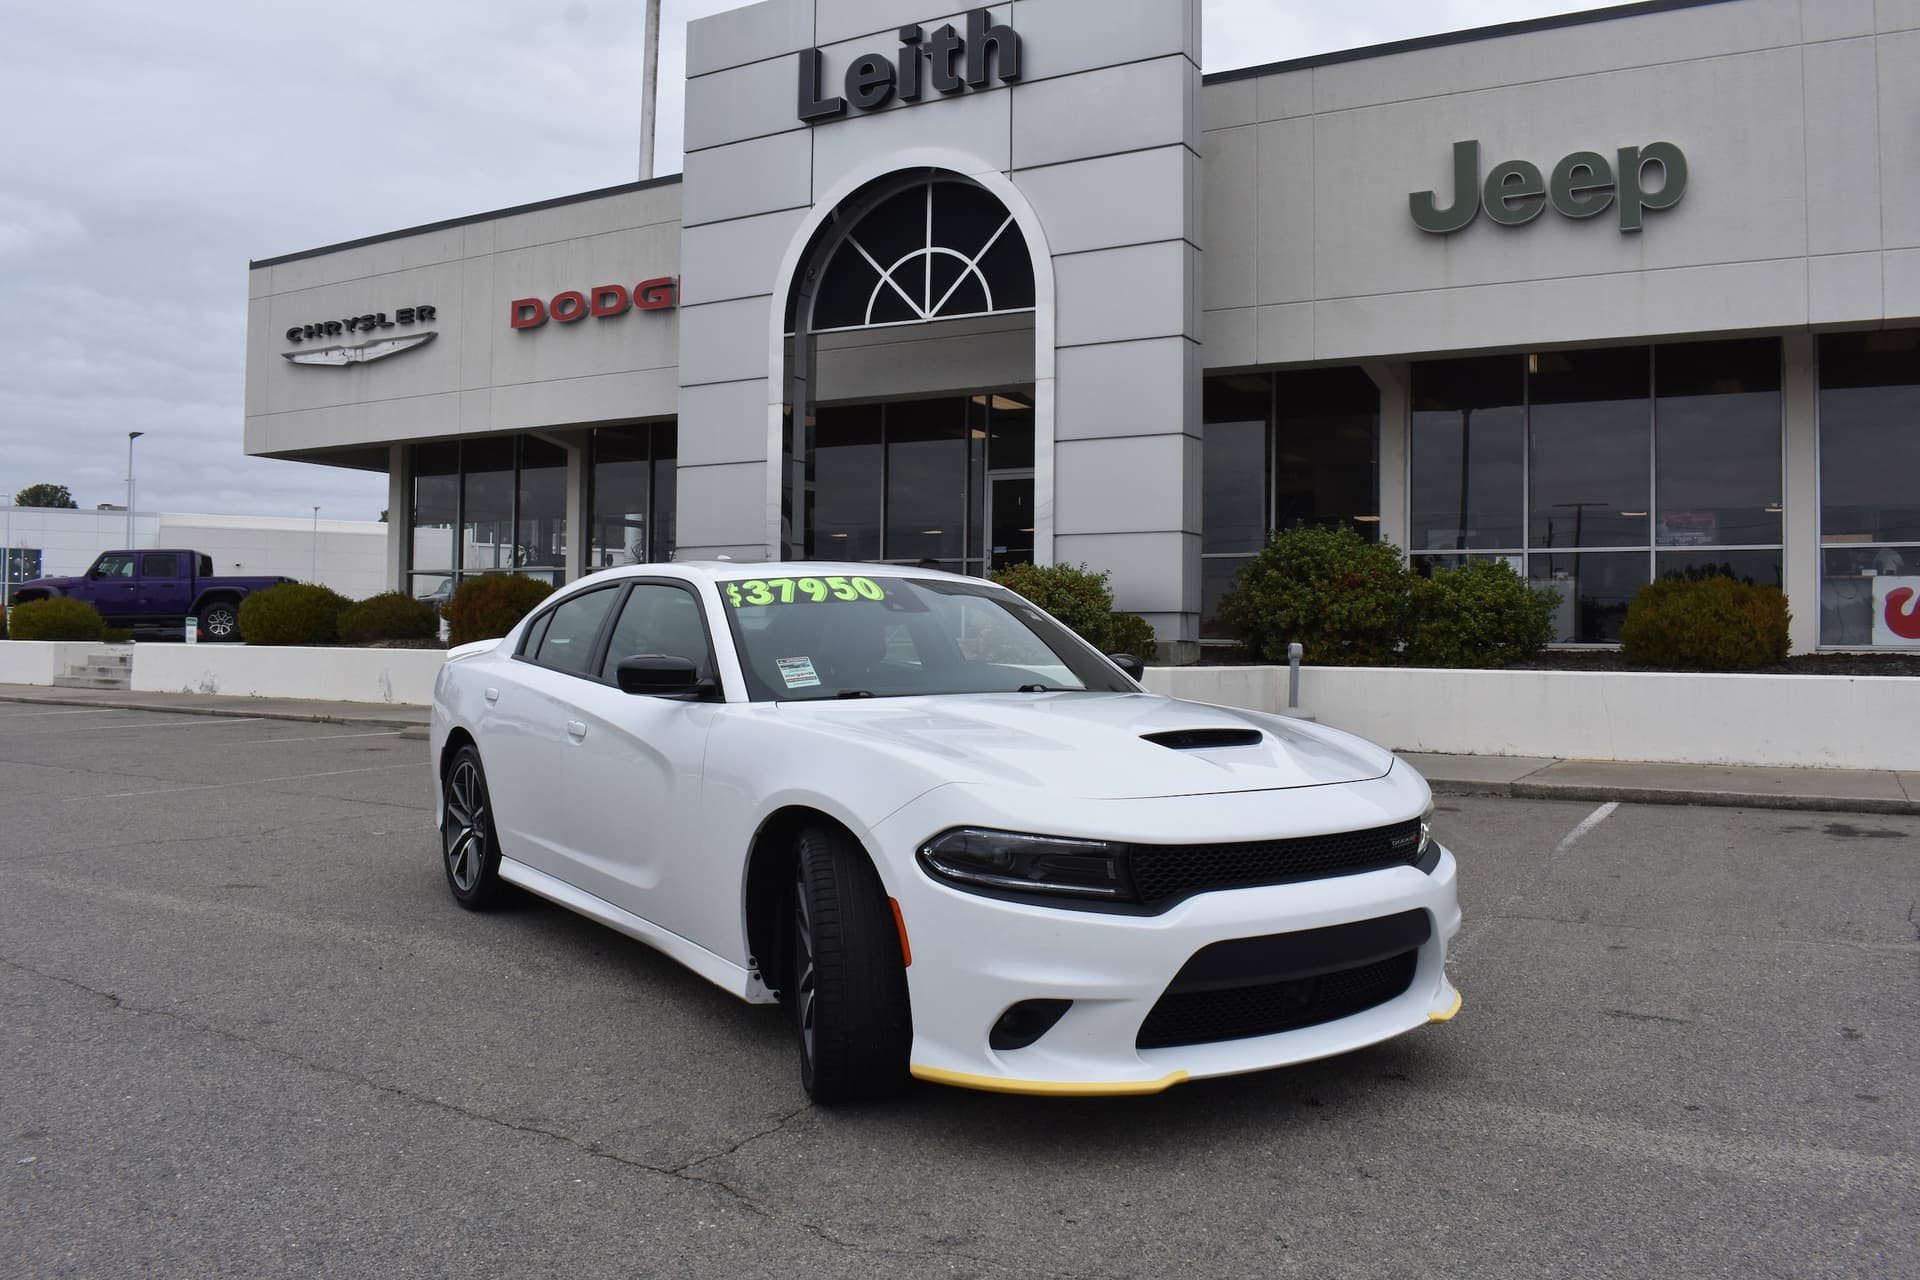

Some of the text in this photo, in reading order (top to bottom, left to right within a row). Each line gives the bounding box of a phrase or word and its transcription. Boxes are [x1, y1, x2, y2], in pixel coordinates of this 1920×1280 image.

[798, 7, 1022, 124] Leith
[1408, 139, 1689, 233] Jeep
[286, 304, 437, 343] CHRYSLER
[510, 273, 681, 329] DODG
[726, 576, 885, 608] $37950
